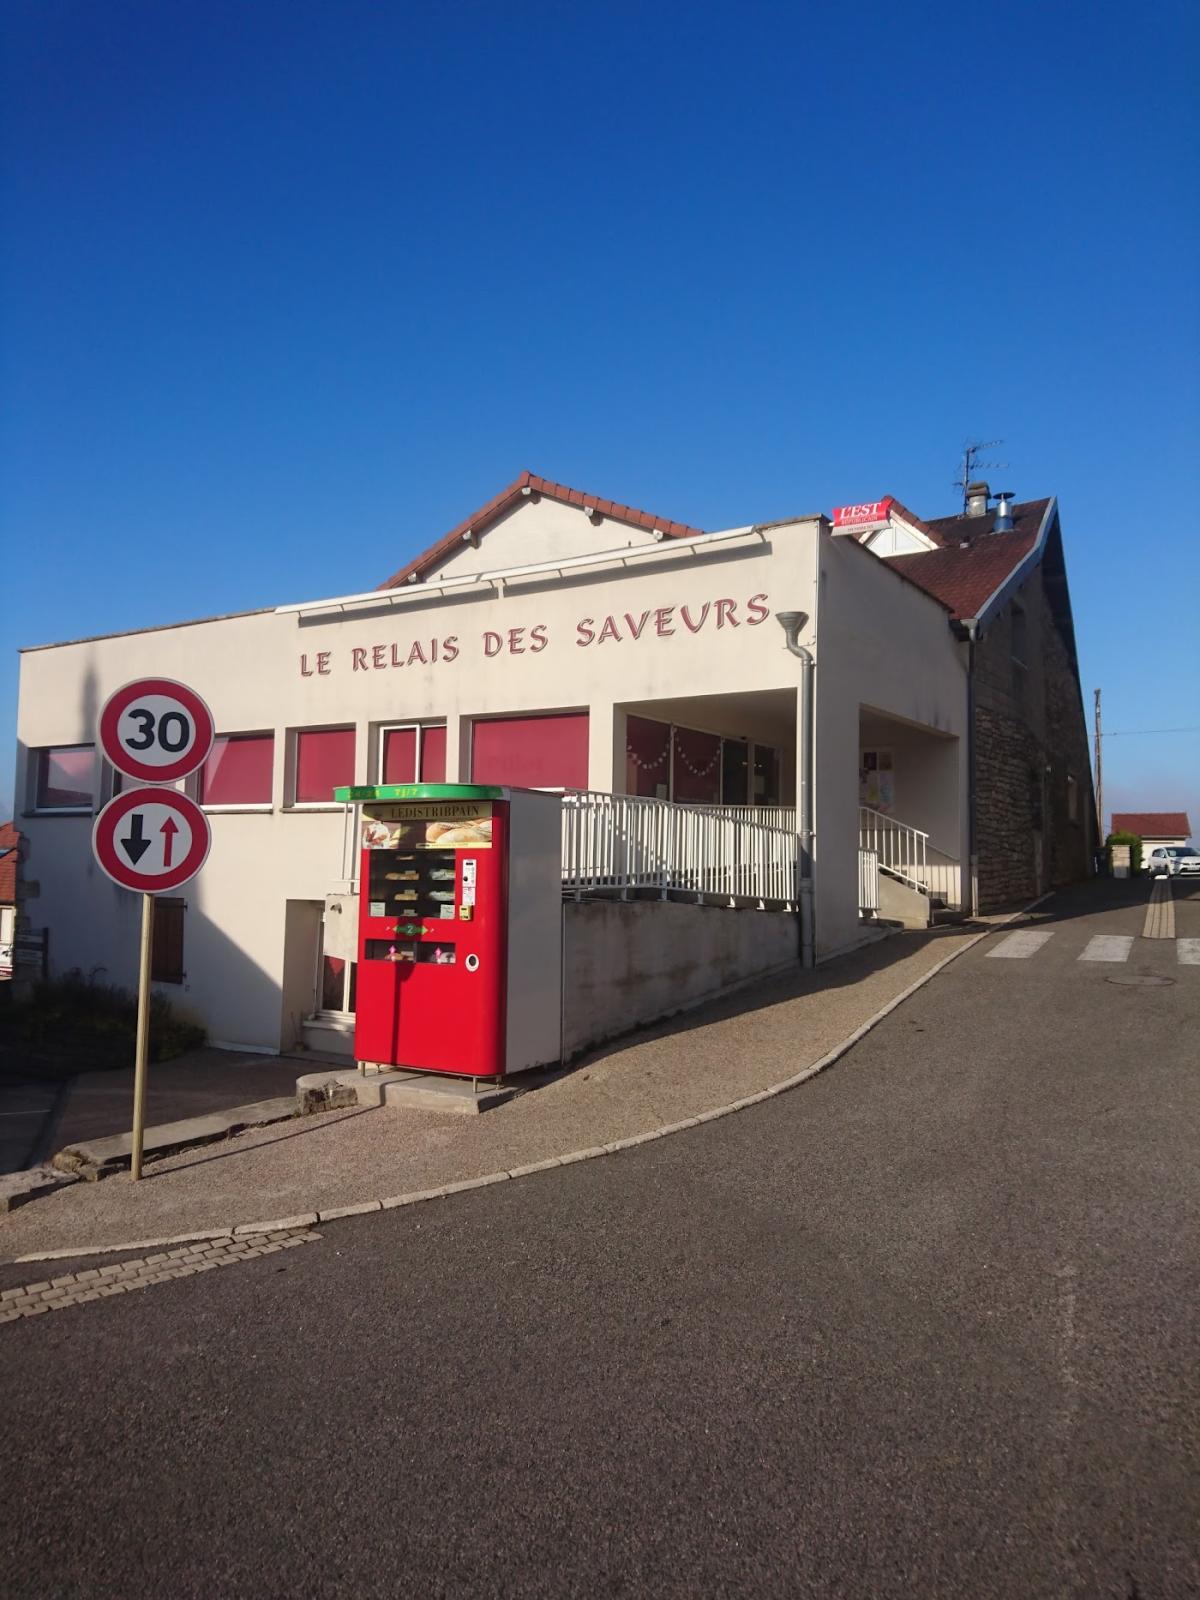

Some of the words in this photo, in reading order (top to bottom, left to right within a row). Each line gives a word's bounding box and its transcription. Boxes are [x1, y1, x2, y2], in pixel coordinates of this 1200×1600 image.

[300, 651, 332, 677] LE
[351, 635, 460, 672] RELAIS
[483, 624, 549, 658] DES
[576, 592, 771, 648] SAVEURS
[125, 708, 190, 753] 30
